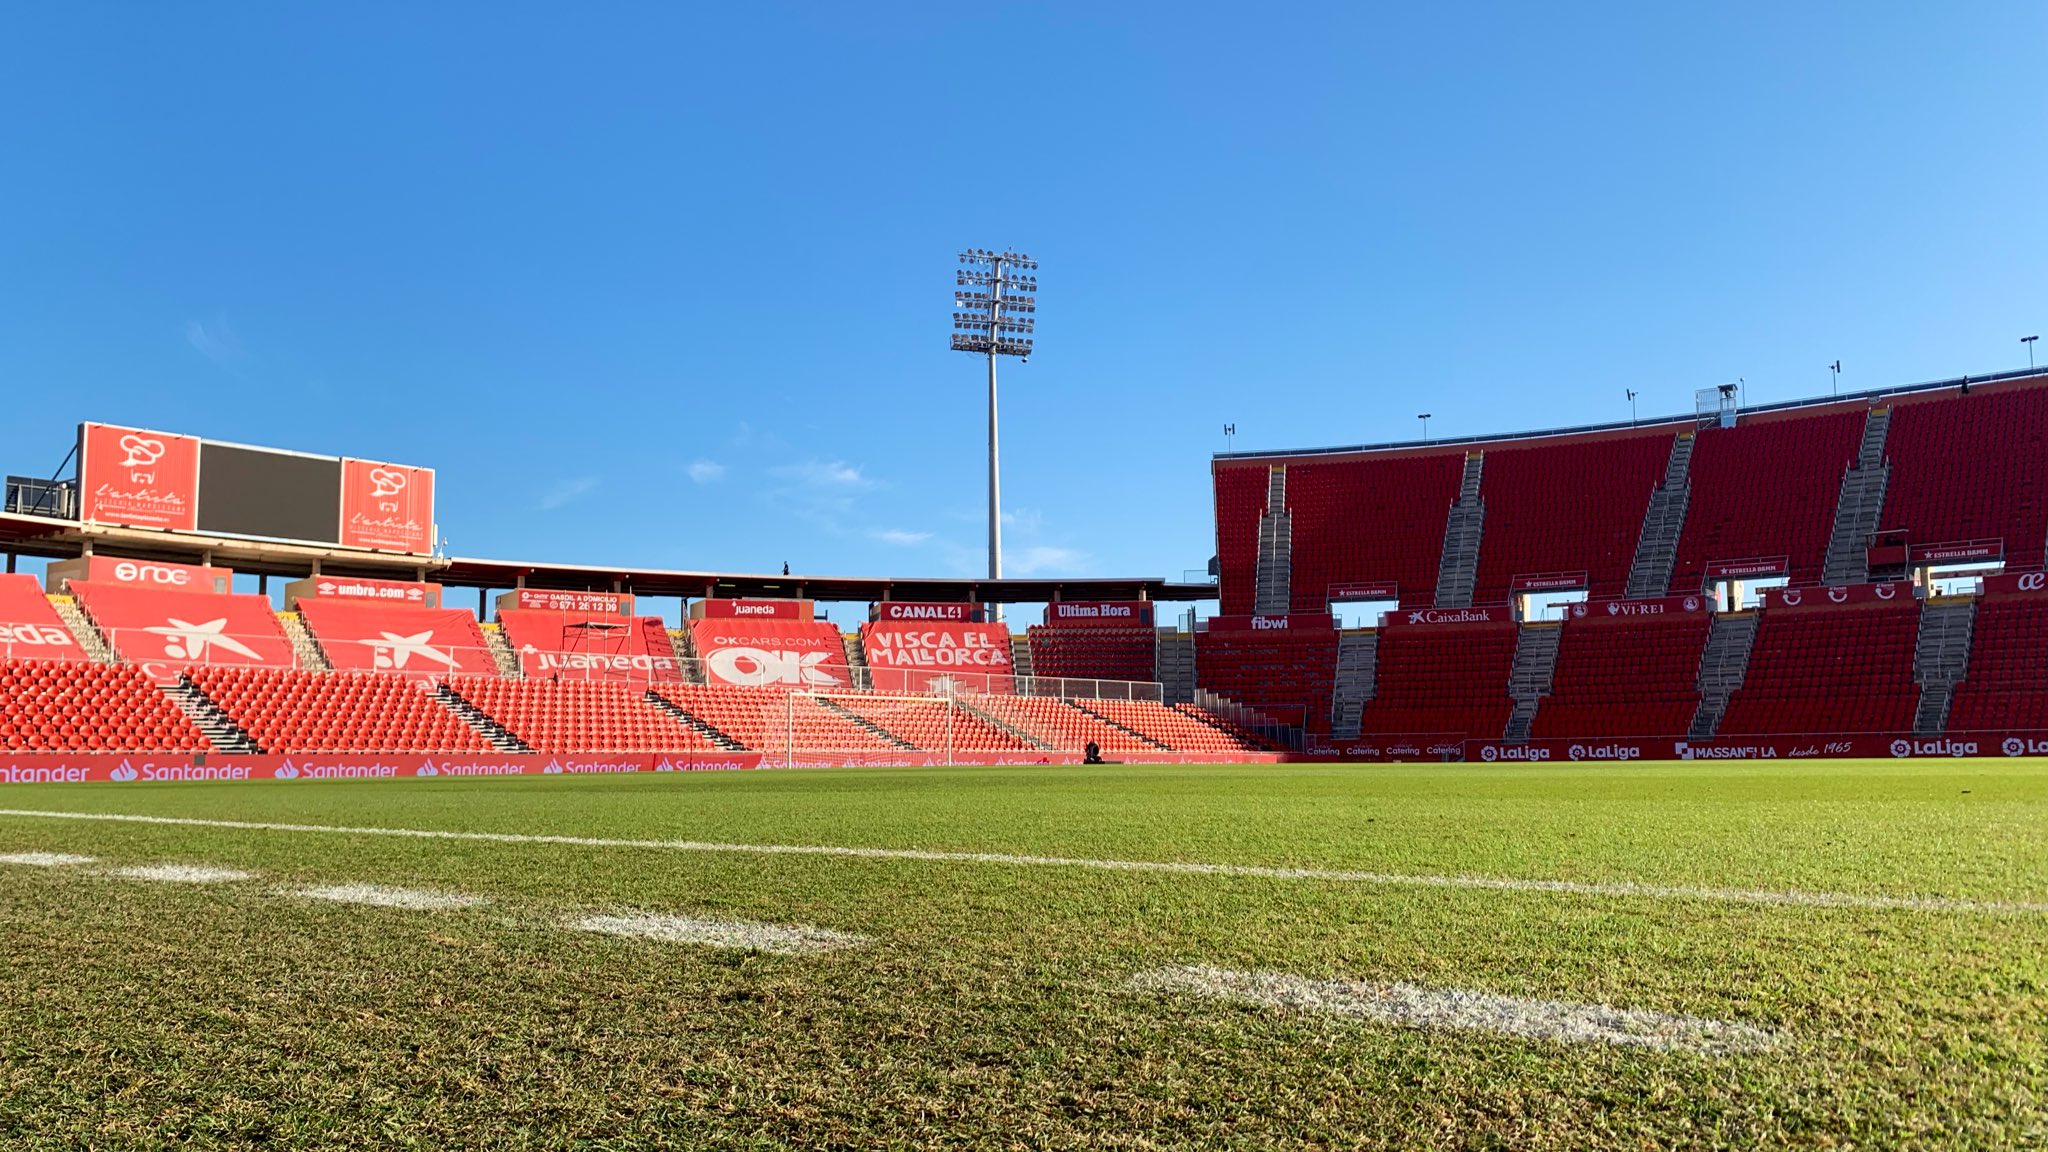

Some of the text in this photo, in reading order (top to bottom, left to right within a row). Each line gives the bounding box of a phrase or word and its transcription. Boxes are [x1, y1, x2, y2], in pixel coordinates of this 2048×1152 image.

[1934, 548, 1989, 559] ESTRELLA DAMM
[1729, 567, 1757, 575] ESTRELLA
[338, 584, 405, 599] umbro.com
[550, 594, 575, 602] GASOIL
[559, 601, 617, 612] 971 26 12 09
[734, 604, 775, 616] juaneda
[1058, 604, 1131, 617] Ultima Hora
[1251, 616, 1289, 630] fibwi
[1426, 609, 1490, 624] CaixaBank
[714, 636, 821, 647] OKCARS.COM
[875, 631, 996, 649] VISCA EL
[536, 652, 673, 671] juaneda
[870, 648, 1008, 666] MALLORCA
[1307, 747, 1340, 757] Catering
[1346, 747, 1380, 757] Catering
[1386, 746, 1420, 756] Catering
[1500, 745, 1550, 761] LaLiga
[1588, 744, 1640, 760] LaLiga
[1823, 742, 1853, 754] 1965
[1914, 739, 1978, 757] LaLiga
[142, 763, 252, 781] Santander
[302, 762, 398, 778] Santander
[441, 761, 525, 776] Santander
[565, 760, 641, 774] Santander
[675, 759, 744, 771] Santander
